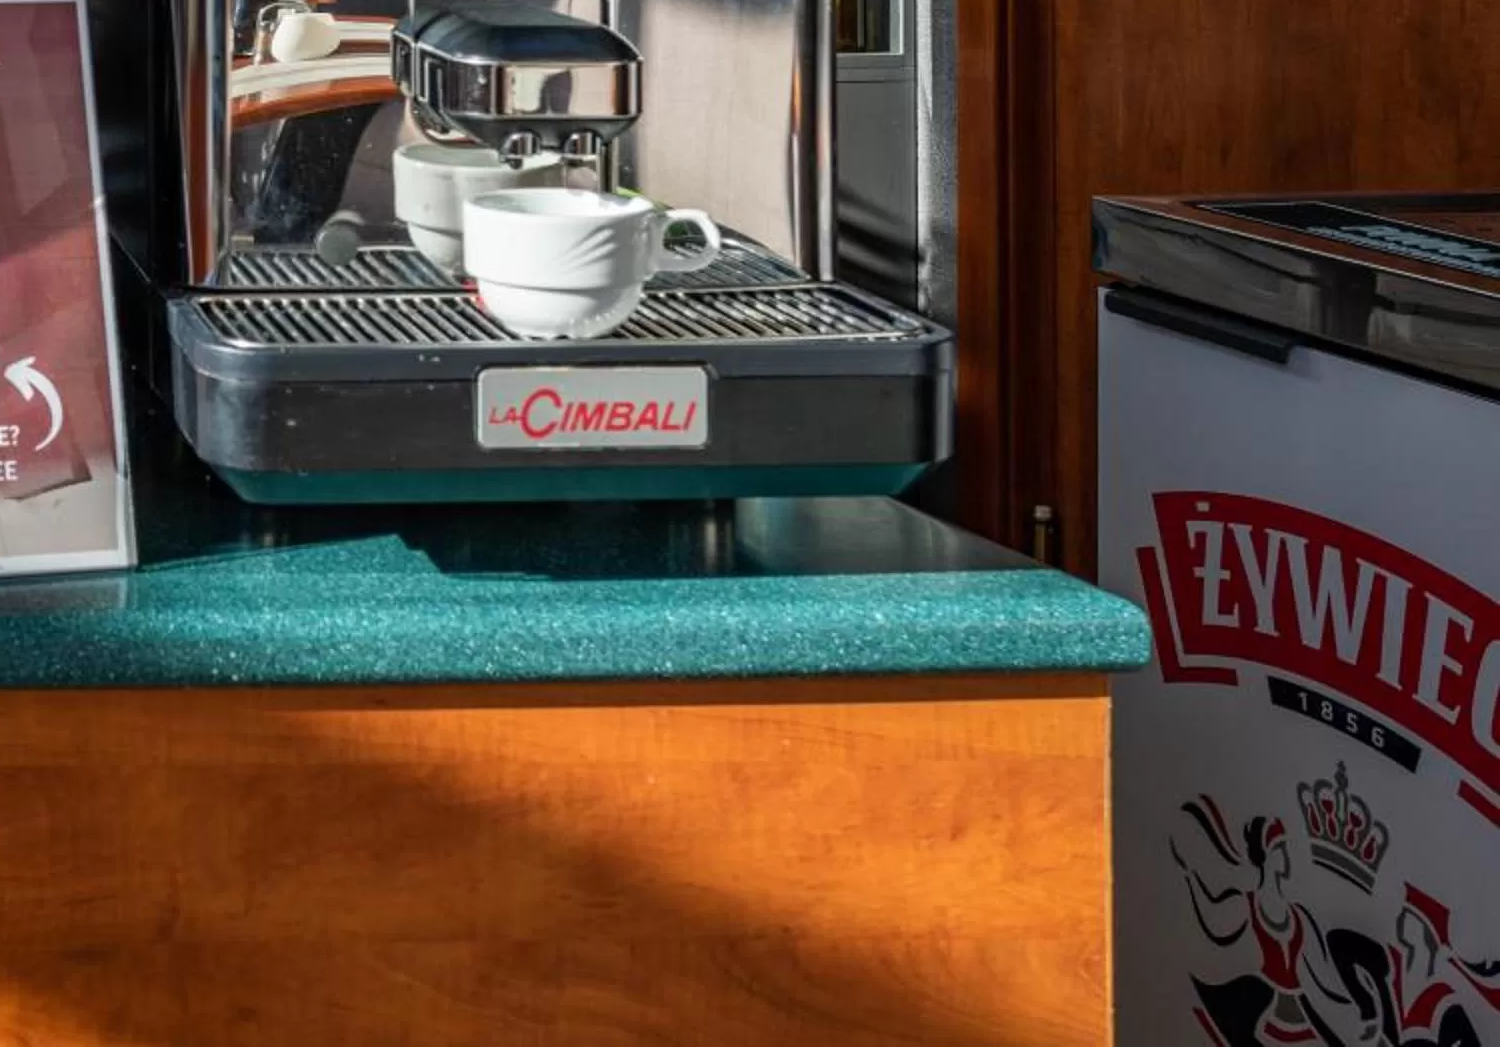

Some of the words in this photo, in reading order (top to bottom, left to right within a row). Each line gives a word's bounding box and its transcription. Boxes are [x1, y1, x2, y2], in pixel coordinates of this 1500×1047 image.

[488, 407, 518, 425] LA
[520, 387, 697, 440] CIMBALI
[1298, 691, 1385, 749] 1856
